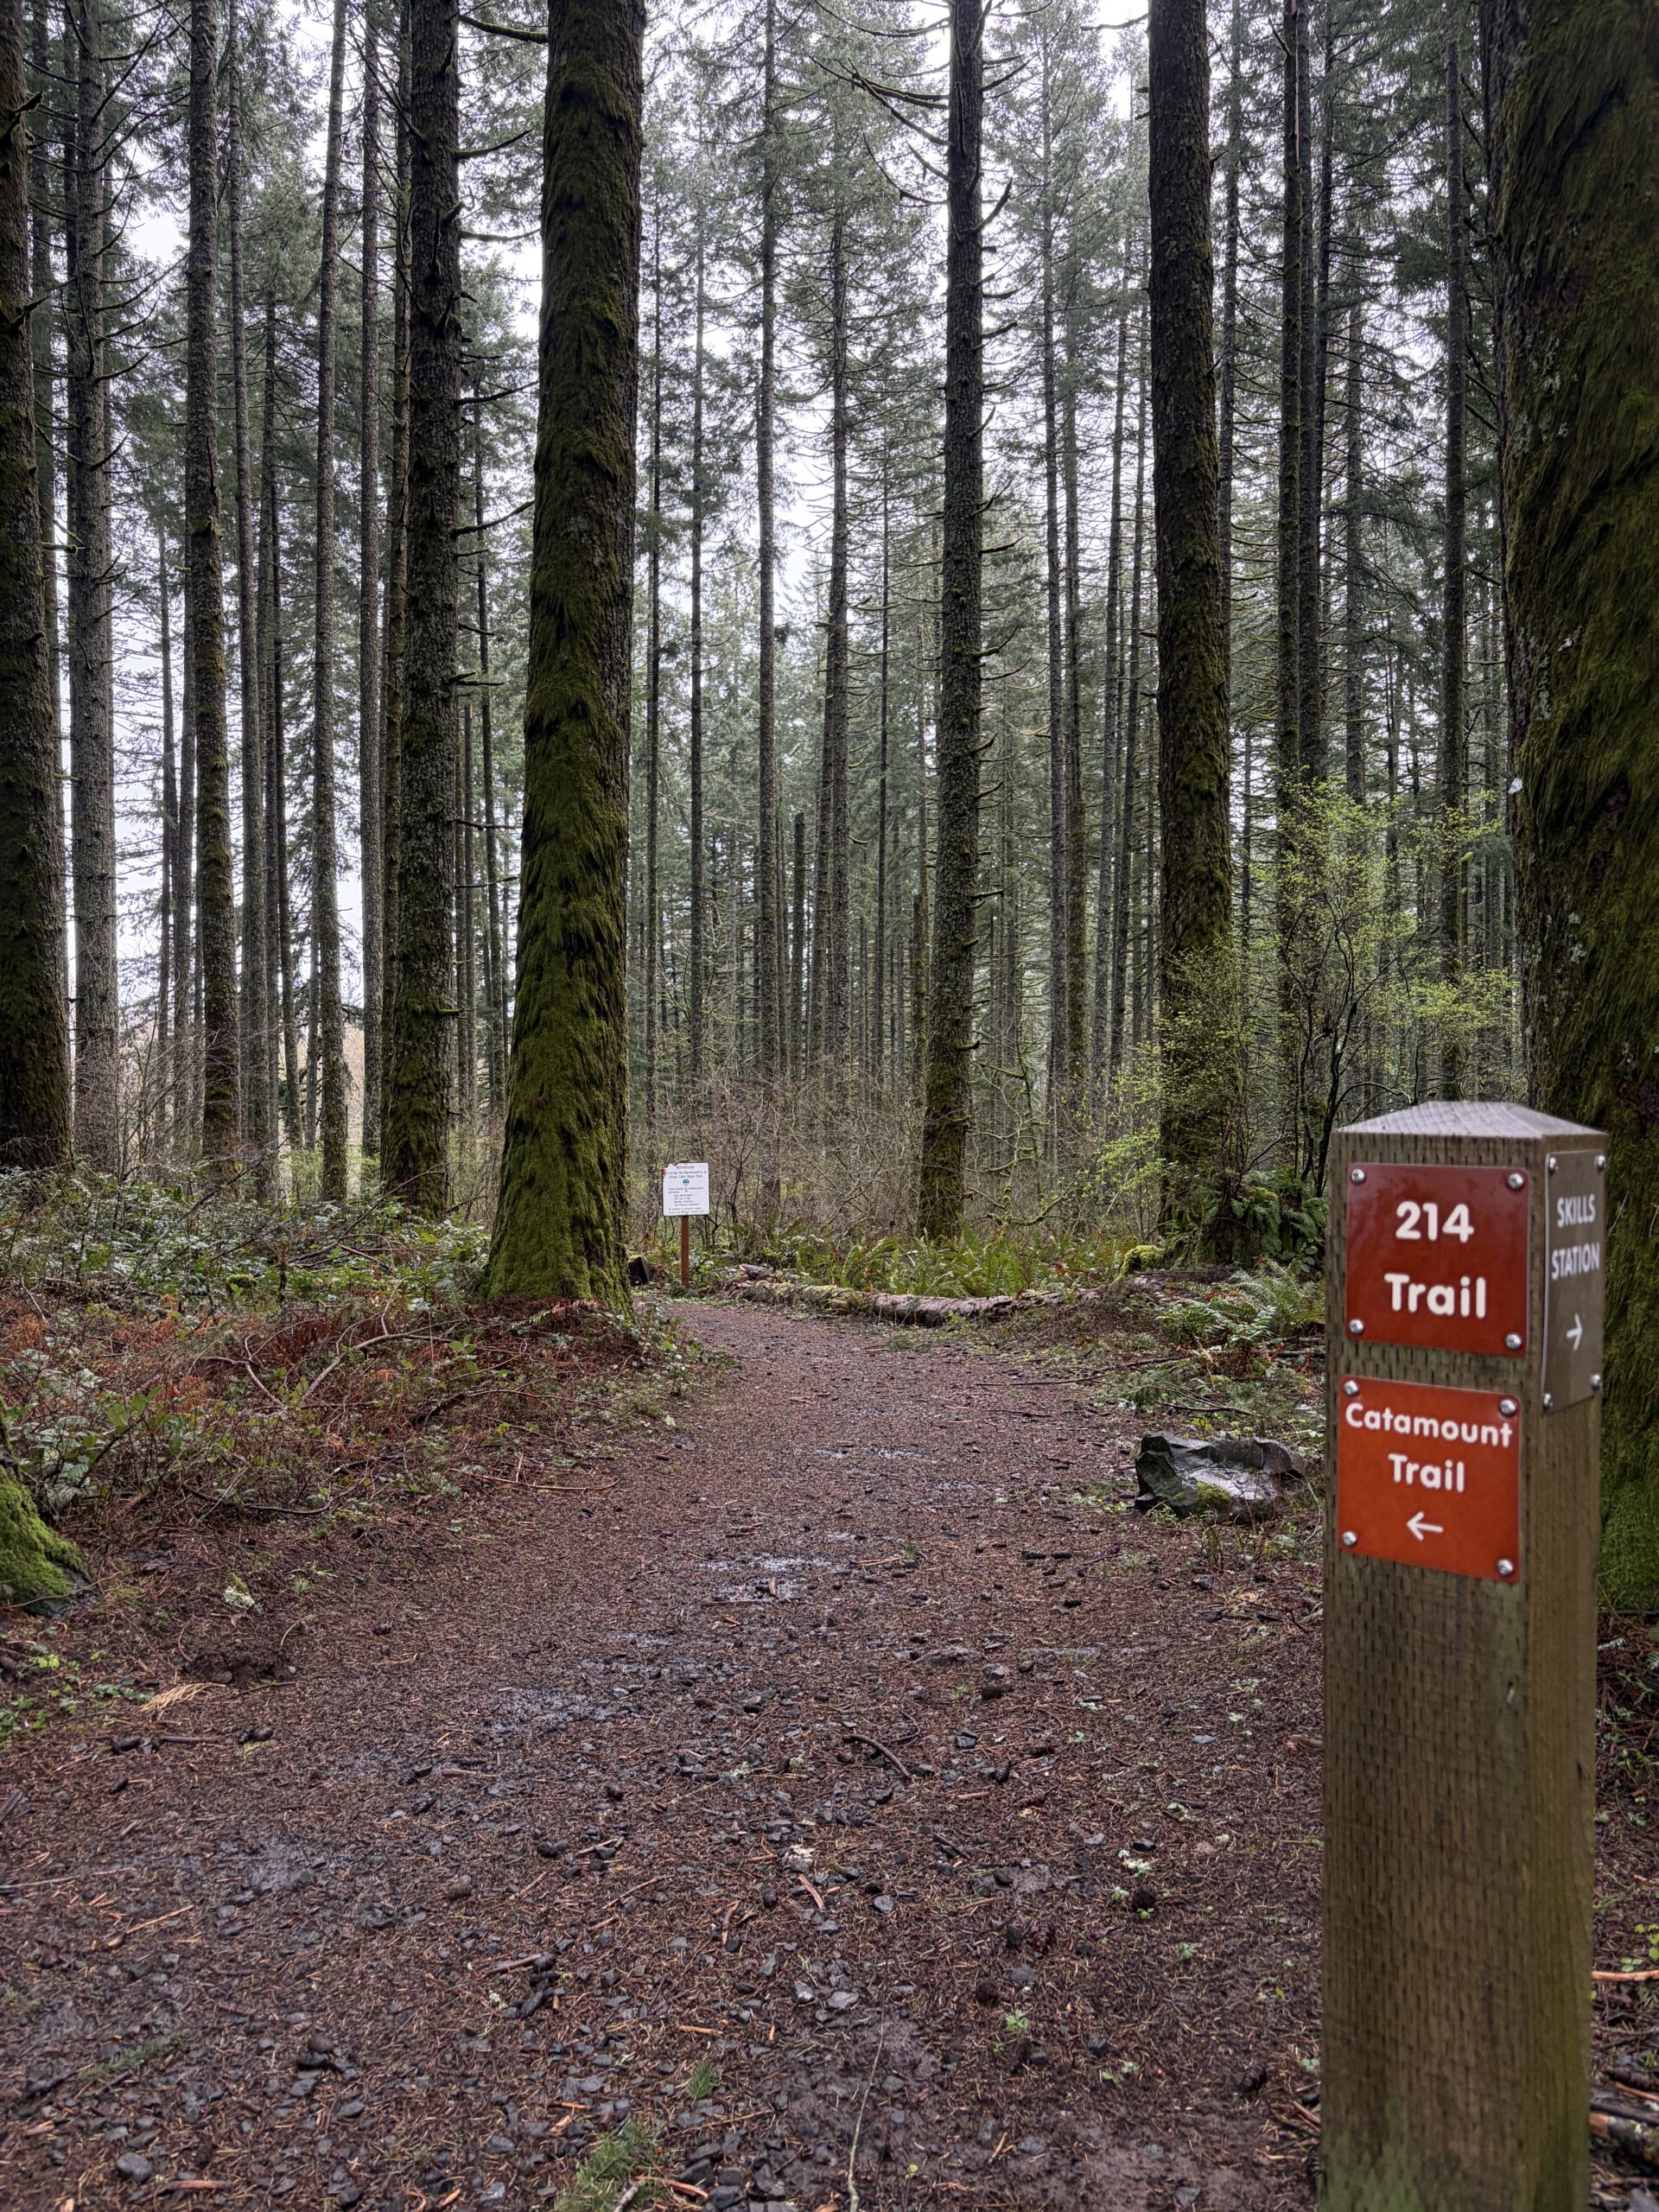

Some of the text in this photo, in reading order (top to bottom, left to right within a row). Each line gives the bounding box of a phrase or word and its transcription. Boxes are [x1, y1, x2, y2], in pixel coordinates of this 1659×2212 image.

[1396, 1202, 1473, 1242] 214
[1557, 1194, 1595, 1227] SKILLS
[1552, 1243, 1599, 1280] STATION
[1384, 1274, 1485, 1318] Trail
[1345, 1402, 1513, 1447] Catamount
[1389, 1454, 1464, 1491] Trail
